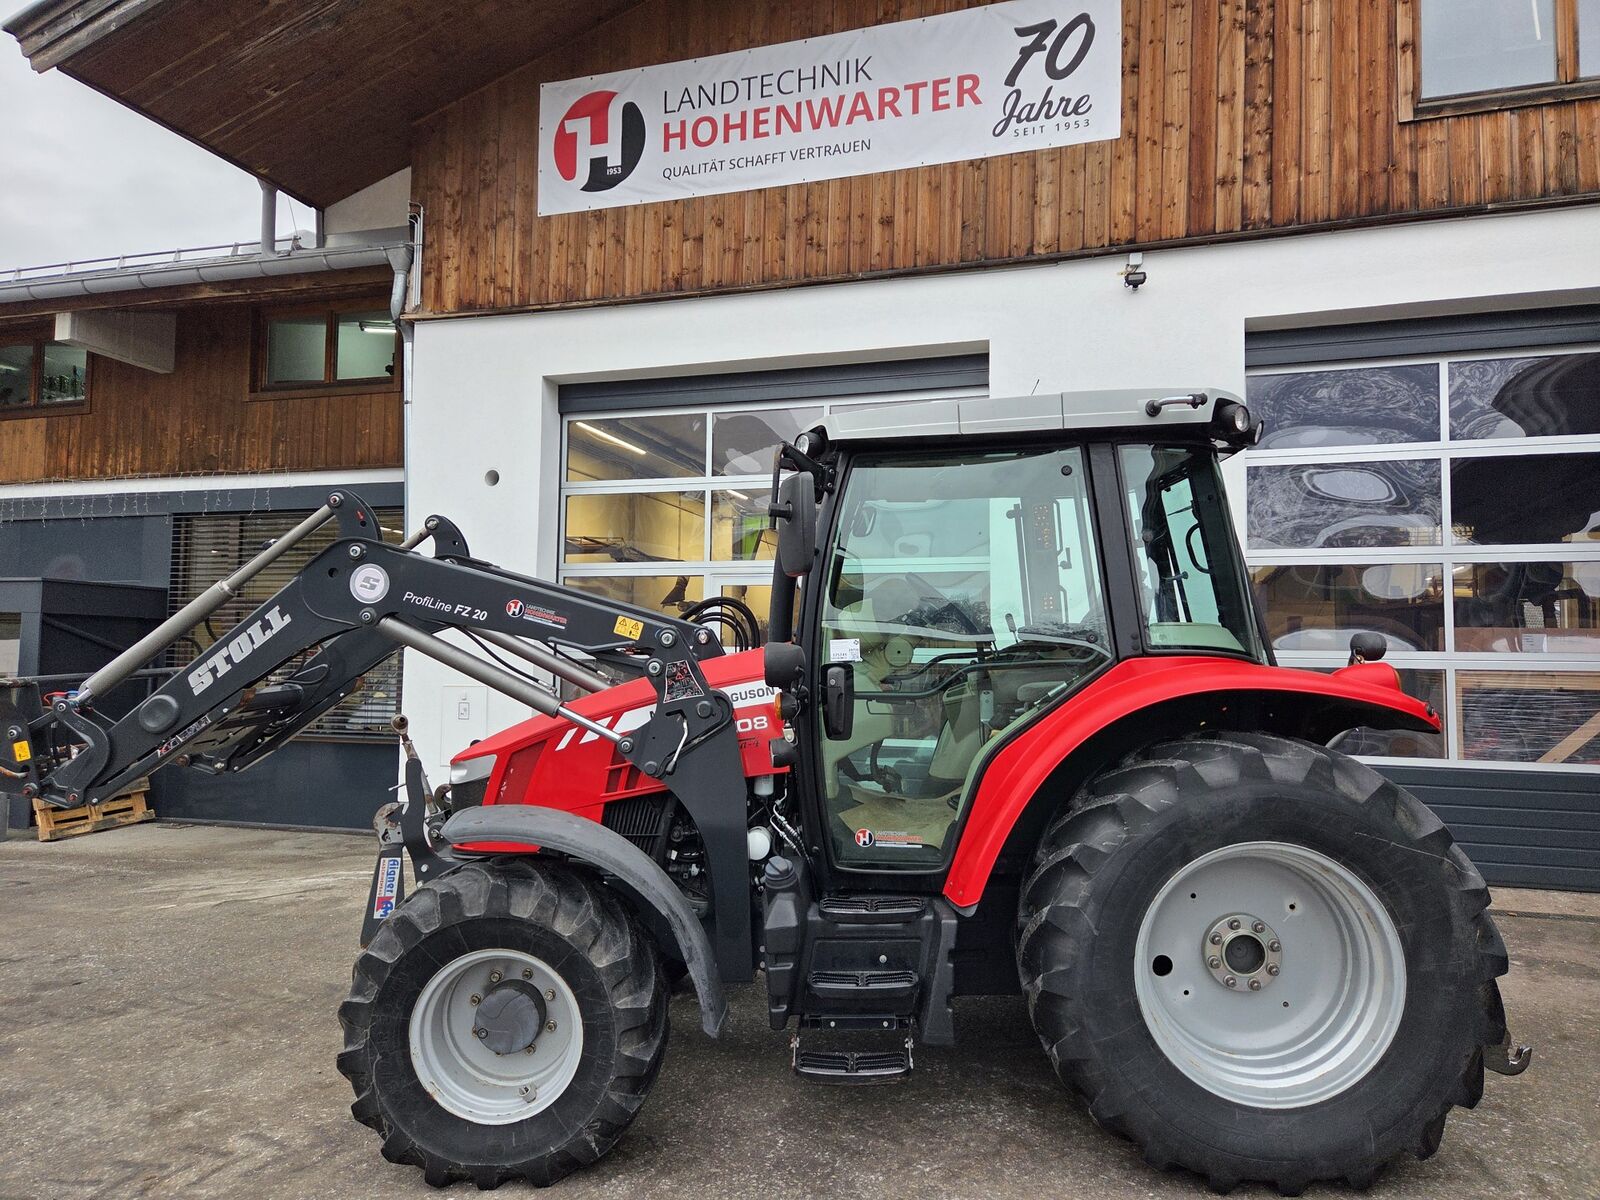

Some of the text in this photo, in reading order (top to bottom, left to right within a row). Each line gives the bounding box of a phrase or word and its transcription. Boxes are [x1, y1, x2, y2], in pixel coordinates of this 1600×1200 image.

[1004, 12, 1095, 87] 70
[664, 56, 872, 114] LANDTECHNIK
[663, 73, 983, 153] HOHENWARTER
[992, 85, 1092, 137] Jahre
[1014, 119, 1090, 137] SEIT 1953
[606, 167, 622, 175] 1953
[662, 139, 871, 180] QUALITÄT SCHAFFT VERTRAUEN
[403, 591, 488, 621] ProfiLine FZ 20
[187, 605, 292, 696] STOLL
[730, 686, 775, 702] GUSON
[736, 715, 768, 733] 08
[387, 859, 400, 893] Aigner
